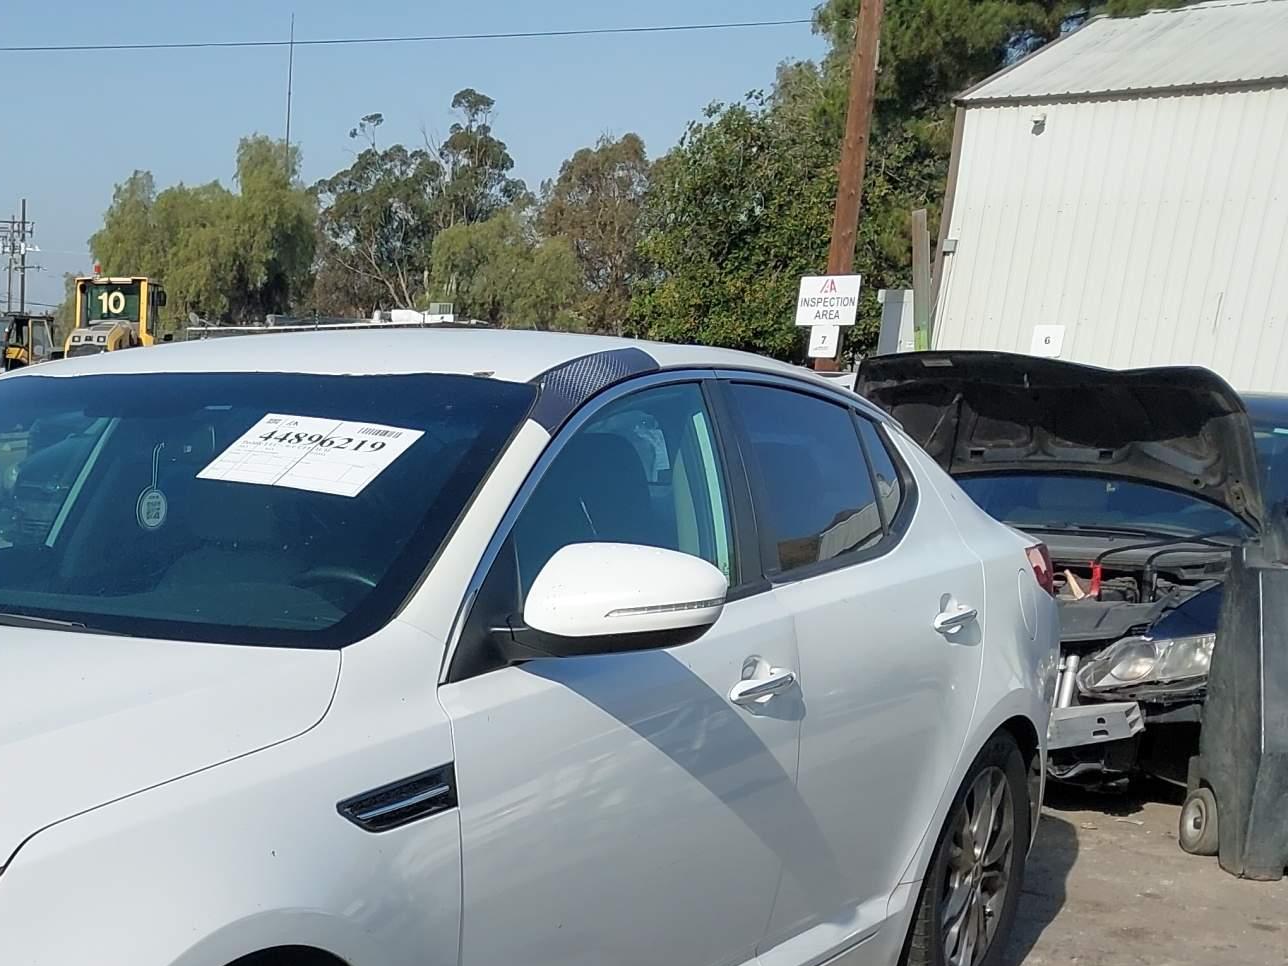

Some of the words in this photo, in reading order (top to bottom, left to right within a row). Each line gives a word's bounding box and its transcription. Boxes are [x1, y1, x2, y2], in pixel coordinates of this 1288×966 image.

[97, 291, 126, 315] 10
[800, 296, 856, 308] INSPECTION
[814, 309, 840, 320] AREA
[821, 335, 827, 345] 7
[1044, 336, 1051, 345] 6
[258, 429, 387, 453] 44896219
